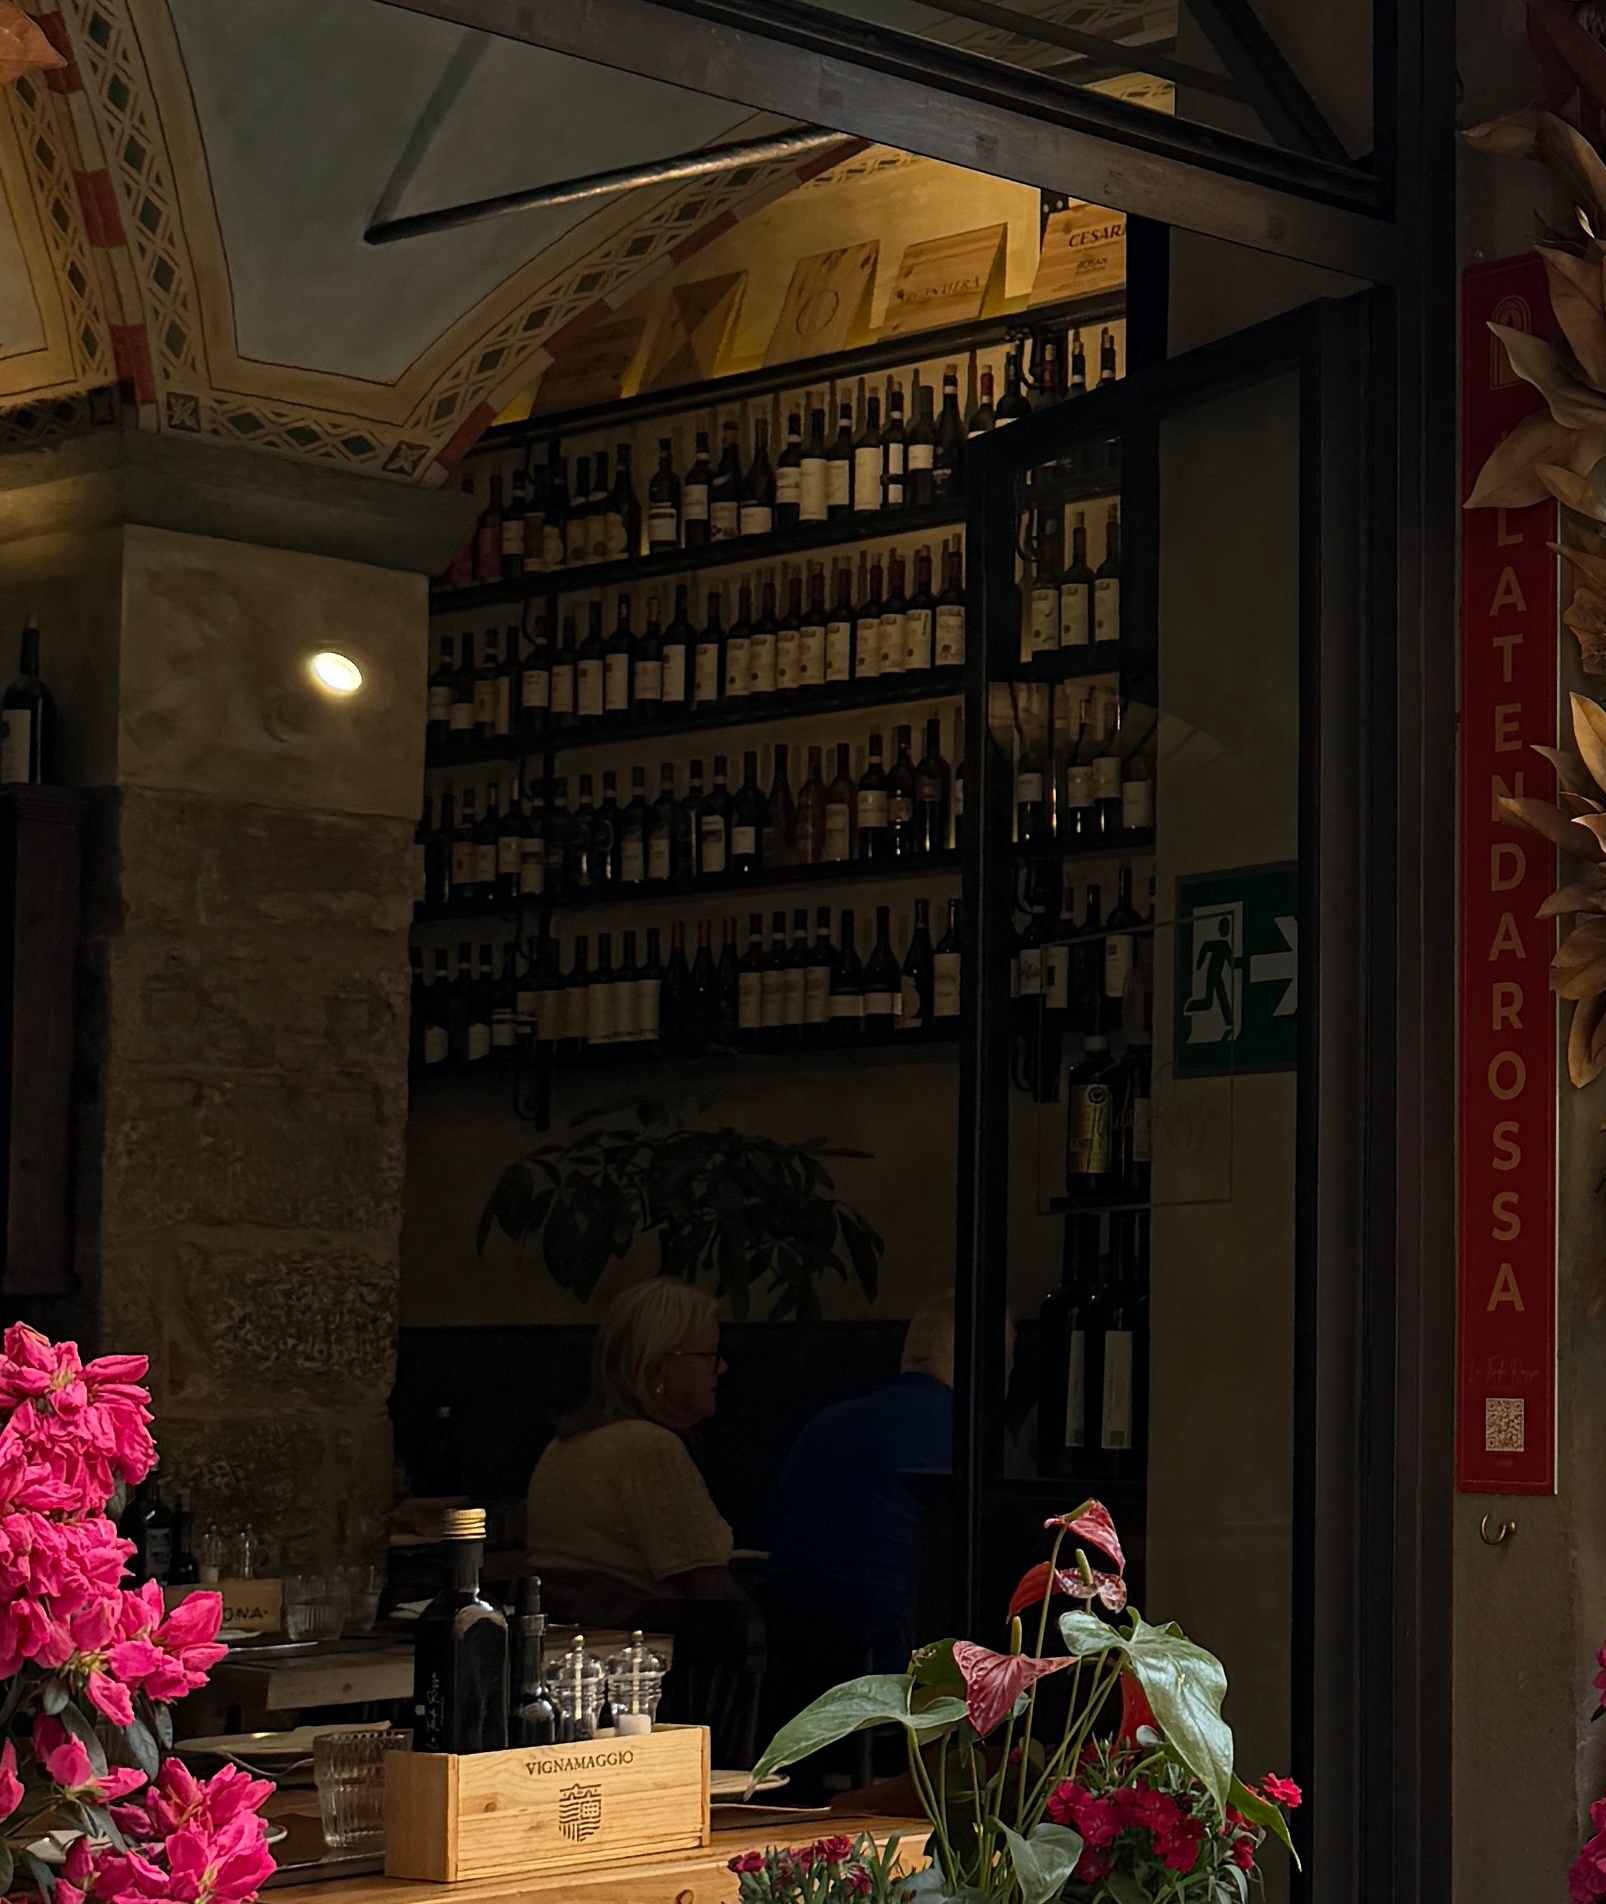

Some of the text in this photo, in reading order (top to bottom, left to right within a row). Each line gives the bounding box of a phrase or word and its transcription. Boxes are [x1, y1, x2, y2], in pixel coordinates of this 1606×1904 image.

[1068, 223, 1125, 247] CESAR
[1483, 429, 1528, 1312] LATENDAROSSA
[525, 1750, 635, 1776] VIGNAMAGGIO
